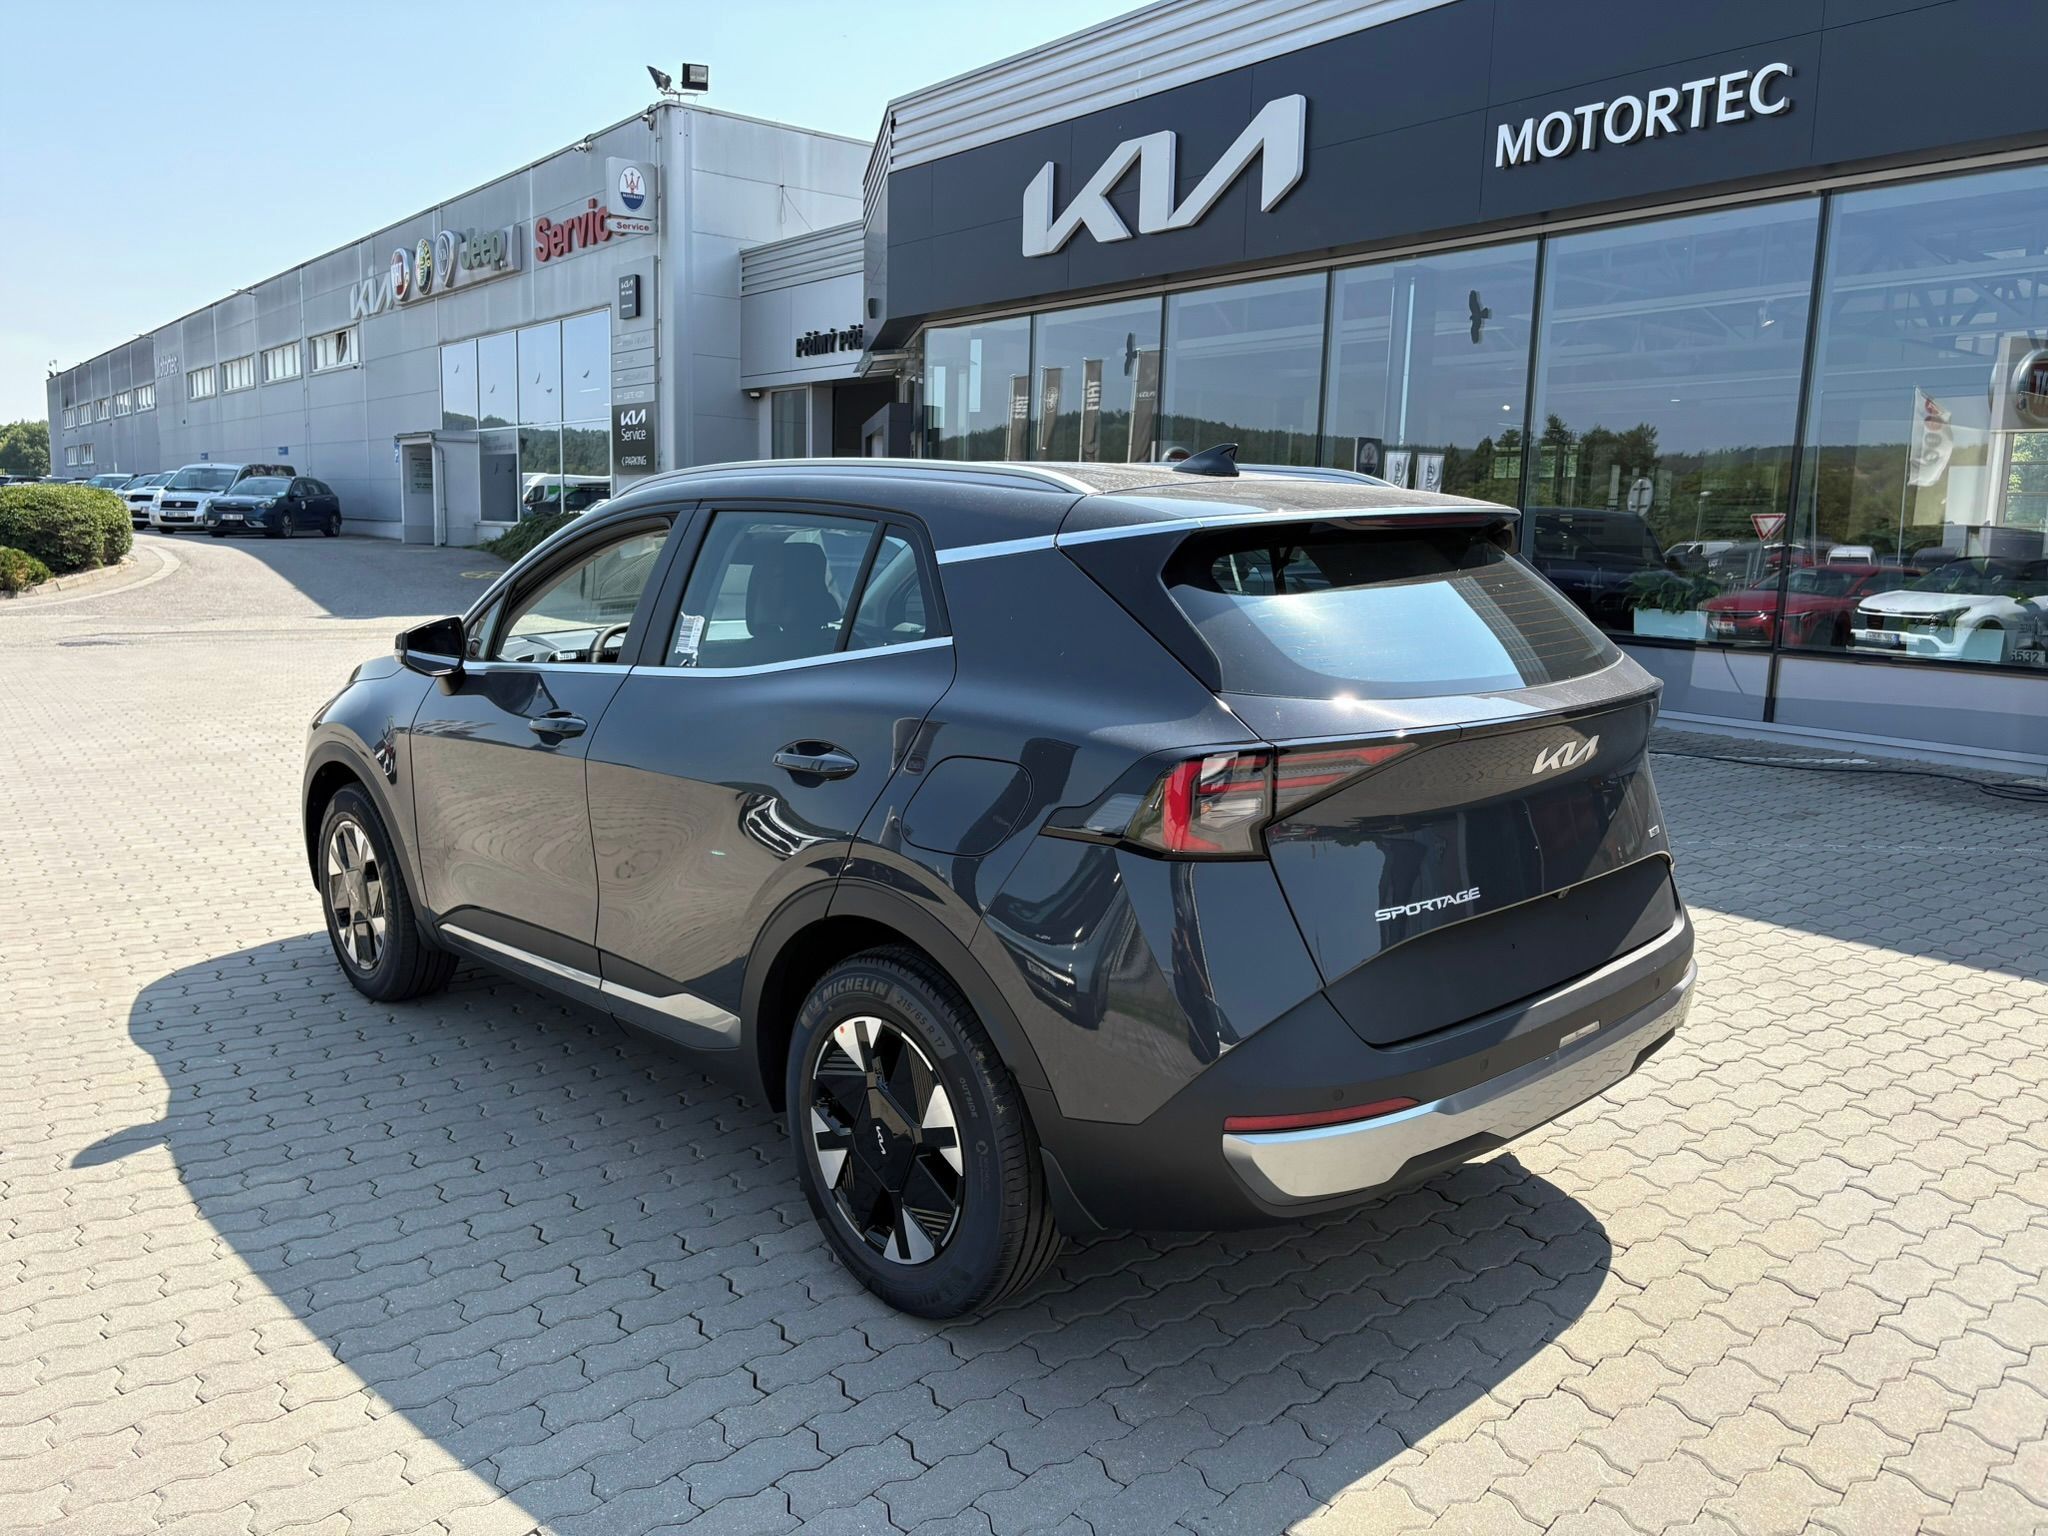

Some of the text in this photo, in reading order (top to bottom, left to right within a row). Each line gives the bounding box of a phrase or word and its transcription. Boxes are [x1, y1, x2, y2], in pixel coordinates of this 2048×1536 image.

[1494, 62, 1793, 169] MOTORTEC
[1022, 93, 1306, 257] KIA
[534, 199, 616, 262] Servic
[616, 221, 649, 232] Service
[460, 228, 507, 270] Jeep
[621, 428, 647, 442] Service
[625, 456, 647, 466] PARKING
[1531, 734, 1599, 775] KIA
[1375, 887, 1481, 922] SPORTAGE
[823, 977, 890, 1000] MICHELIN
[896, 996, 927, 1026] 215/65
[959, 1077, 978, 1119] OUTSIDE
